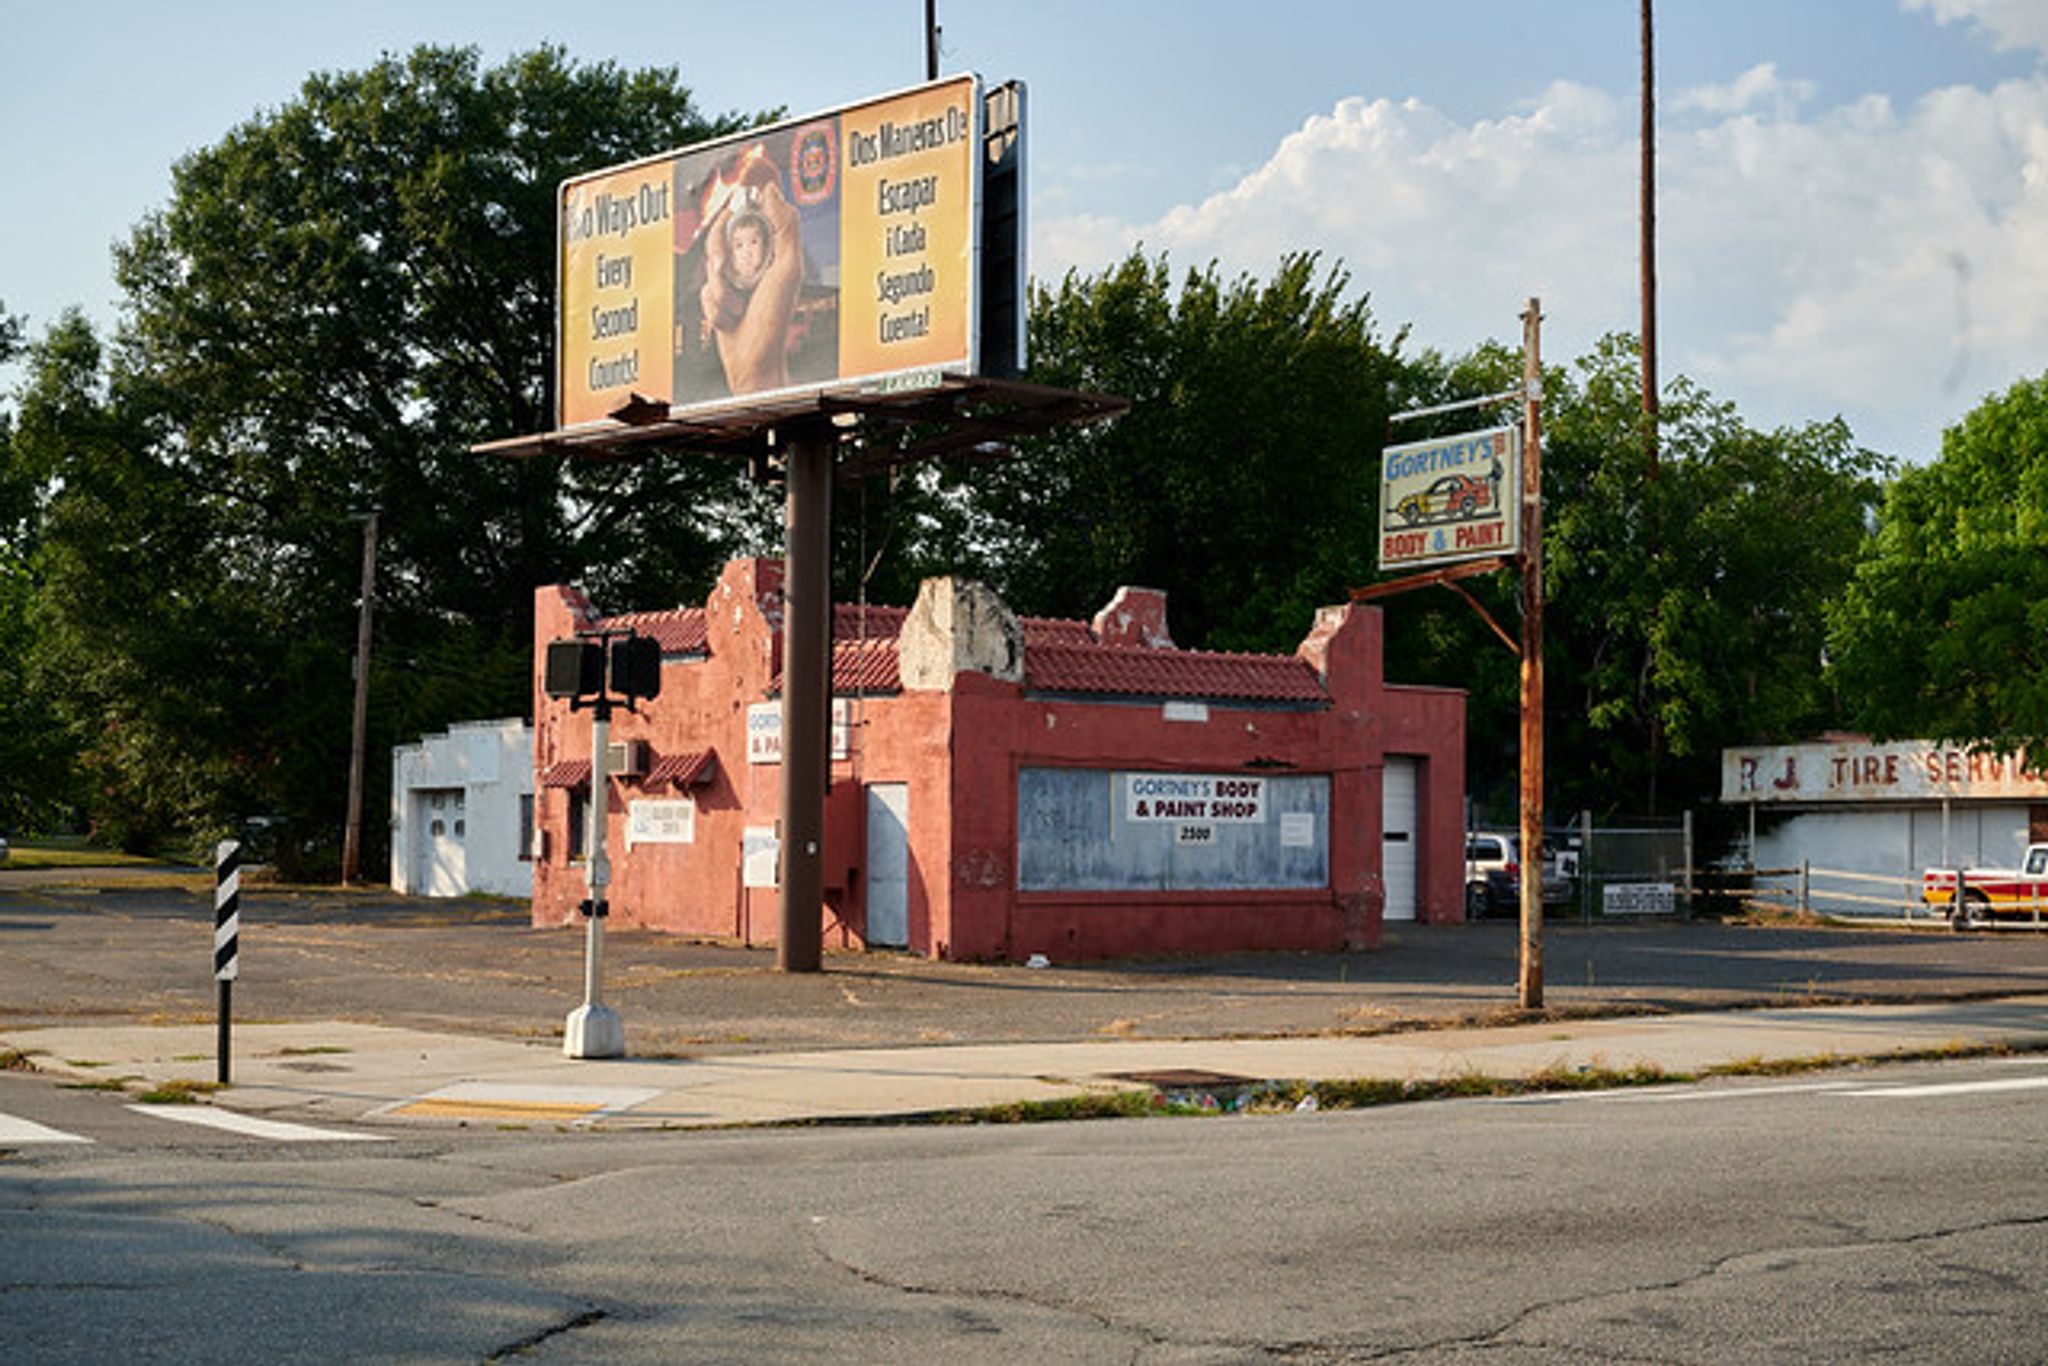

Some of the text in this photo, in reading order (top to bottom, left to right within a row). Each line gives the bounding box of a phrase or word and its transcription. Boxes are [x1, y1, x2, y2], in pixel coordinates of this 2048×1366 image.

[850, 131, 877, 167] Dos
[880, 118, 945, 160] Maneras
[595, 192, 636, 238] Ways
[640, 181, 669, 225] Out
[880, 176, 937, 216] Escapar
[597, 253, 632, 289] Every
[877, 263, 934, 304] Segundo
[591, 298, 638, 341] Second
[880, 305, 929, 344] Cuenta!
[589, 348, 638, 391] Counts!
[1383, 522, 1505, 560] BODY & PAINT
[1216, 781, 1261, 798] BODY
[1738, 757, 1758, 792] R
[1831, 755, 1899, 788] TIRE
[1136, 800, 1257, 818] & PAINT SHOP
